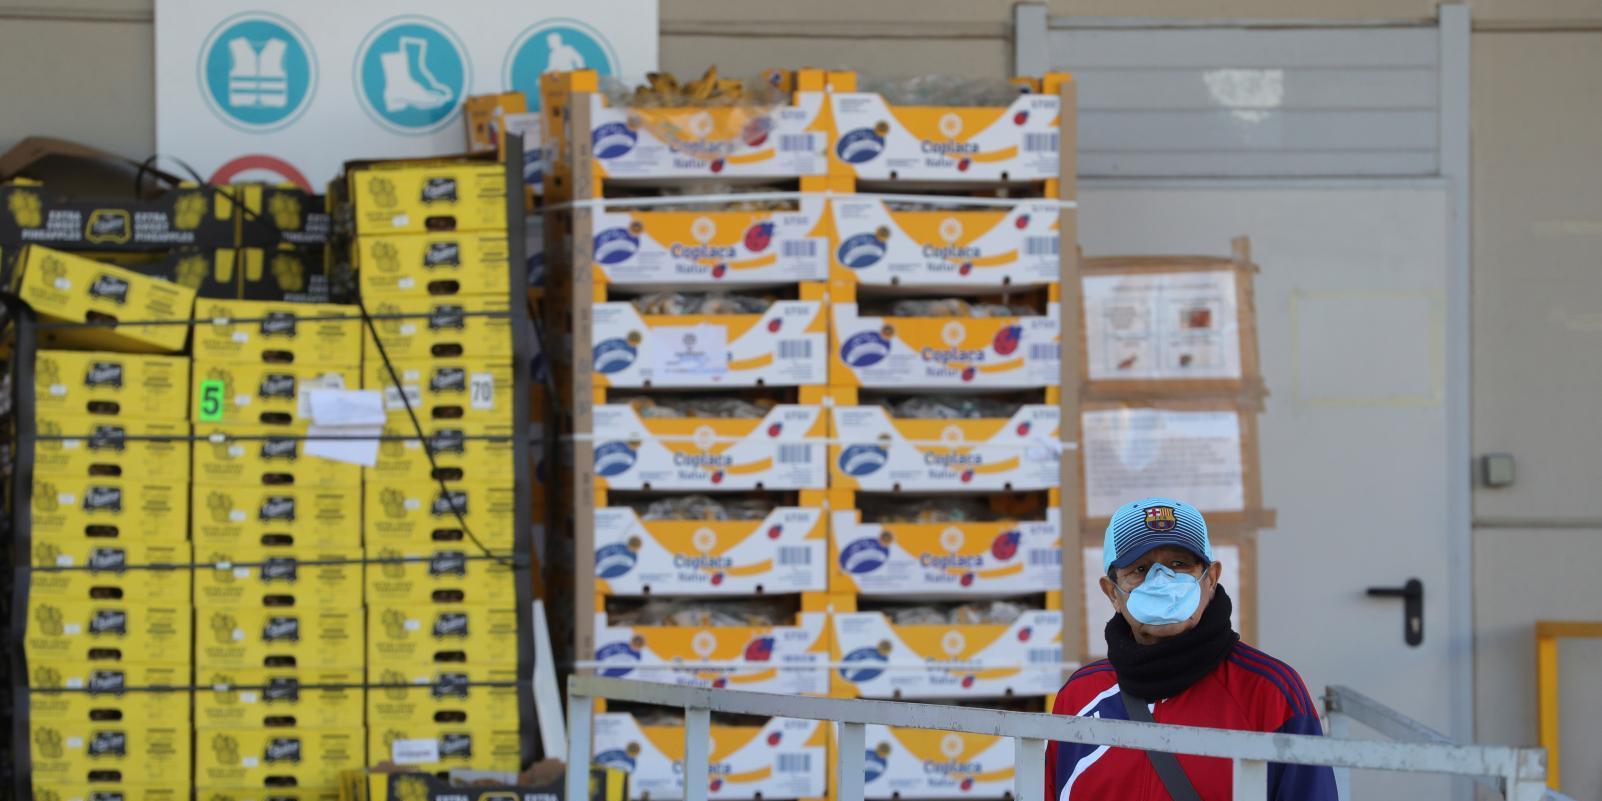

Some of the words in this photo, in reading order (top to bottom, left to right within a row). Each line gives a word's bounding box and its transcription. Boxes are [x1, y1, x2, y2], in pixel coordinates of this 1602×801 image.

[922, 140, 980, 156] Coplaca
[671, 243, 737, 260] Coplaca
[922, 243, 982, 260] Coplaca
[921, 346, 985, 364] Coplaca
[472, 381, 491, 402] 70
[203, 387, 220, 415] 5
[674, 453, 733, 469] Coplaca
[924, 452, 983, 468] Coplaca
[673, 554, 733, 570] Coplaca
[920, 553, 984, 570] Coplaca
[923, 760, 983, 777] Coplaca
